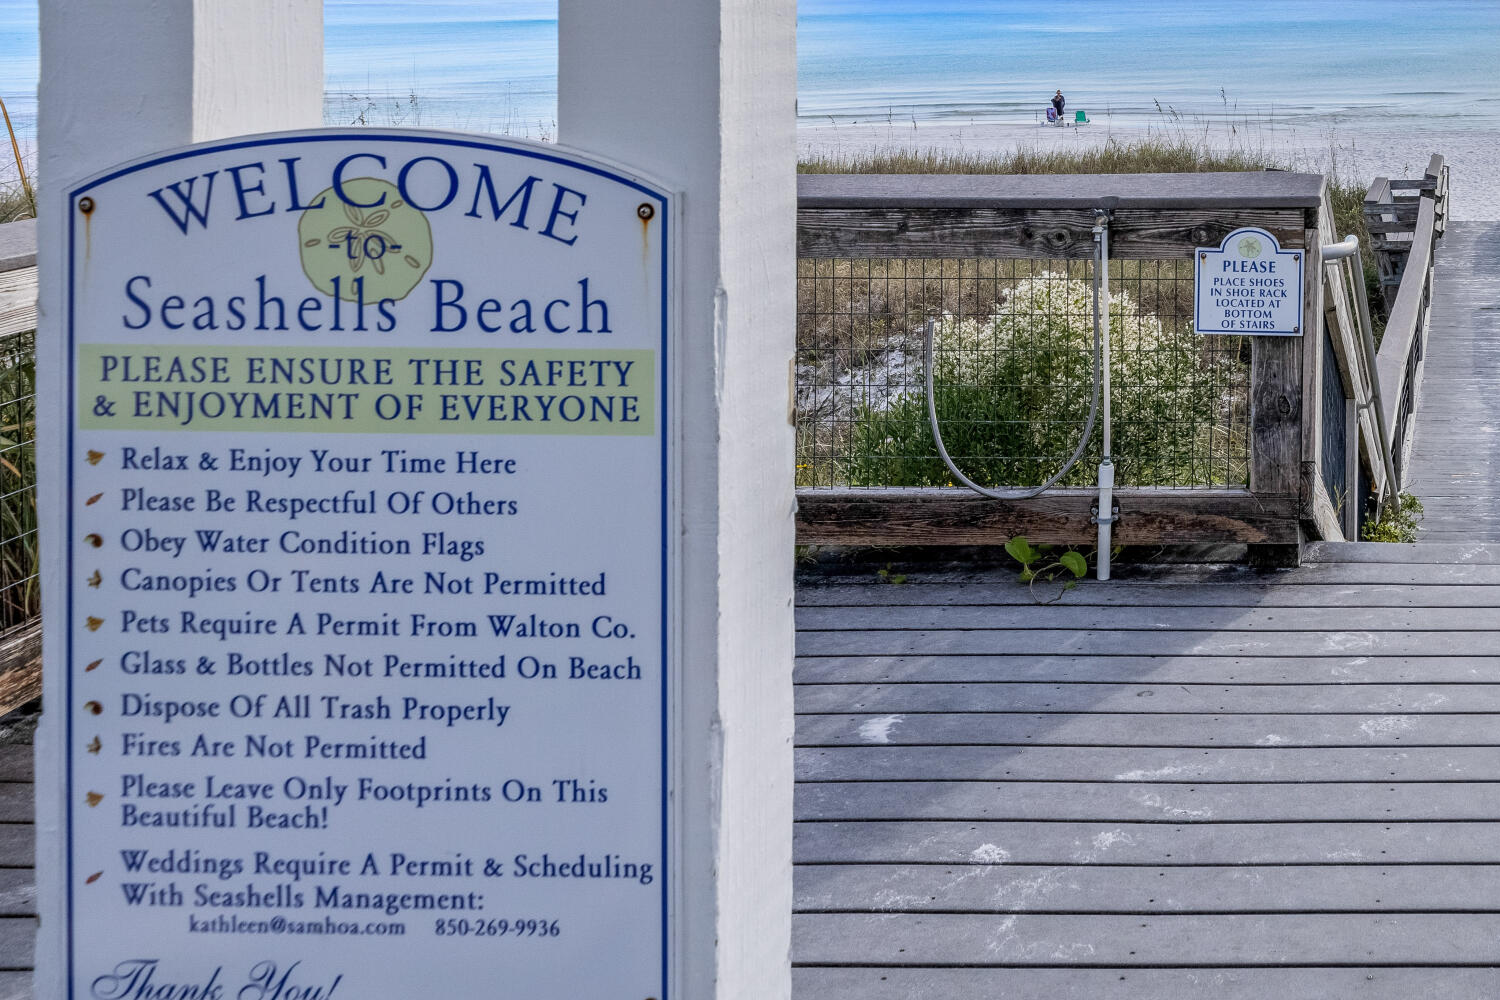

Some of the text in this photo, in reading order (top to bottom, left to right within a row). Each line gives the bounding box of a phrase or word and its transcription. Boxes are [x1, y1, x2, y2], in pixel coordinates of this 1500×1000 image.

[145, 151, 589, 248] WELCOME
[1213, 277, 1285, 288] PLACE SHOES
[1223, 260, 1276, 274] PLEASE
[121, 273, 613, 334] Seashells Beach
[1210, 287, 1288, 298] IN SHOE RACK
[1216, 298, 1282, 309] LOCATED AT
[1221, 319, 1275, 330] OF STAIRS
[1224, 309, 1273, 319] BOTTOM
[100, 355, 635, 387] PLEASE ENSURE THE SAFETY
[92, 391, 640, 426] & ENJOYMENT OF EVERYONE
[121, 446, 517, 478] Relax & Enjoy Your Time Here
[121, 487, 518, 520] Please Be Respectful Of Others
[120, 528, 485, 562] Obey Water Condition Flags
[120, 568, 606, 599] Canopies Or Tents Are Not Permitted
[121, 609, 636, 641] Pets Require A Permit From Walton Co.
[120, 650, 641, 680] Glass & Bottles Not Permitted On Beach
[121, 693, 511, 727] Dispose Of All Trash Properly
[122, 732, 426, 760] Fires Are Not Permitted
[121, 773, 608, 808] Please Leave Only Footprints On This
[121, 803, 328, 829] Beautiful Beach!
[119, 849, 654, 885] Weddings Require A Permit & Scheduling
[121, 882, 484, 916] With Seashells Management:
[189, 913, 561, 937] kathleen@samhoa.com 850-269-9936
[91, 959, 223, 1000] Thank
